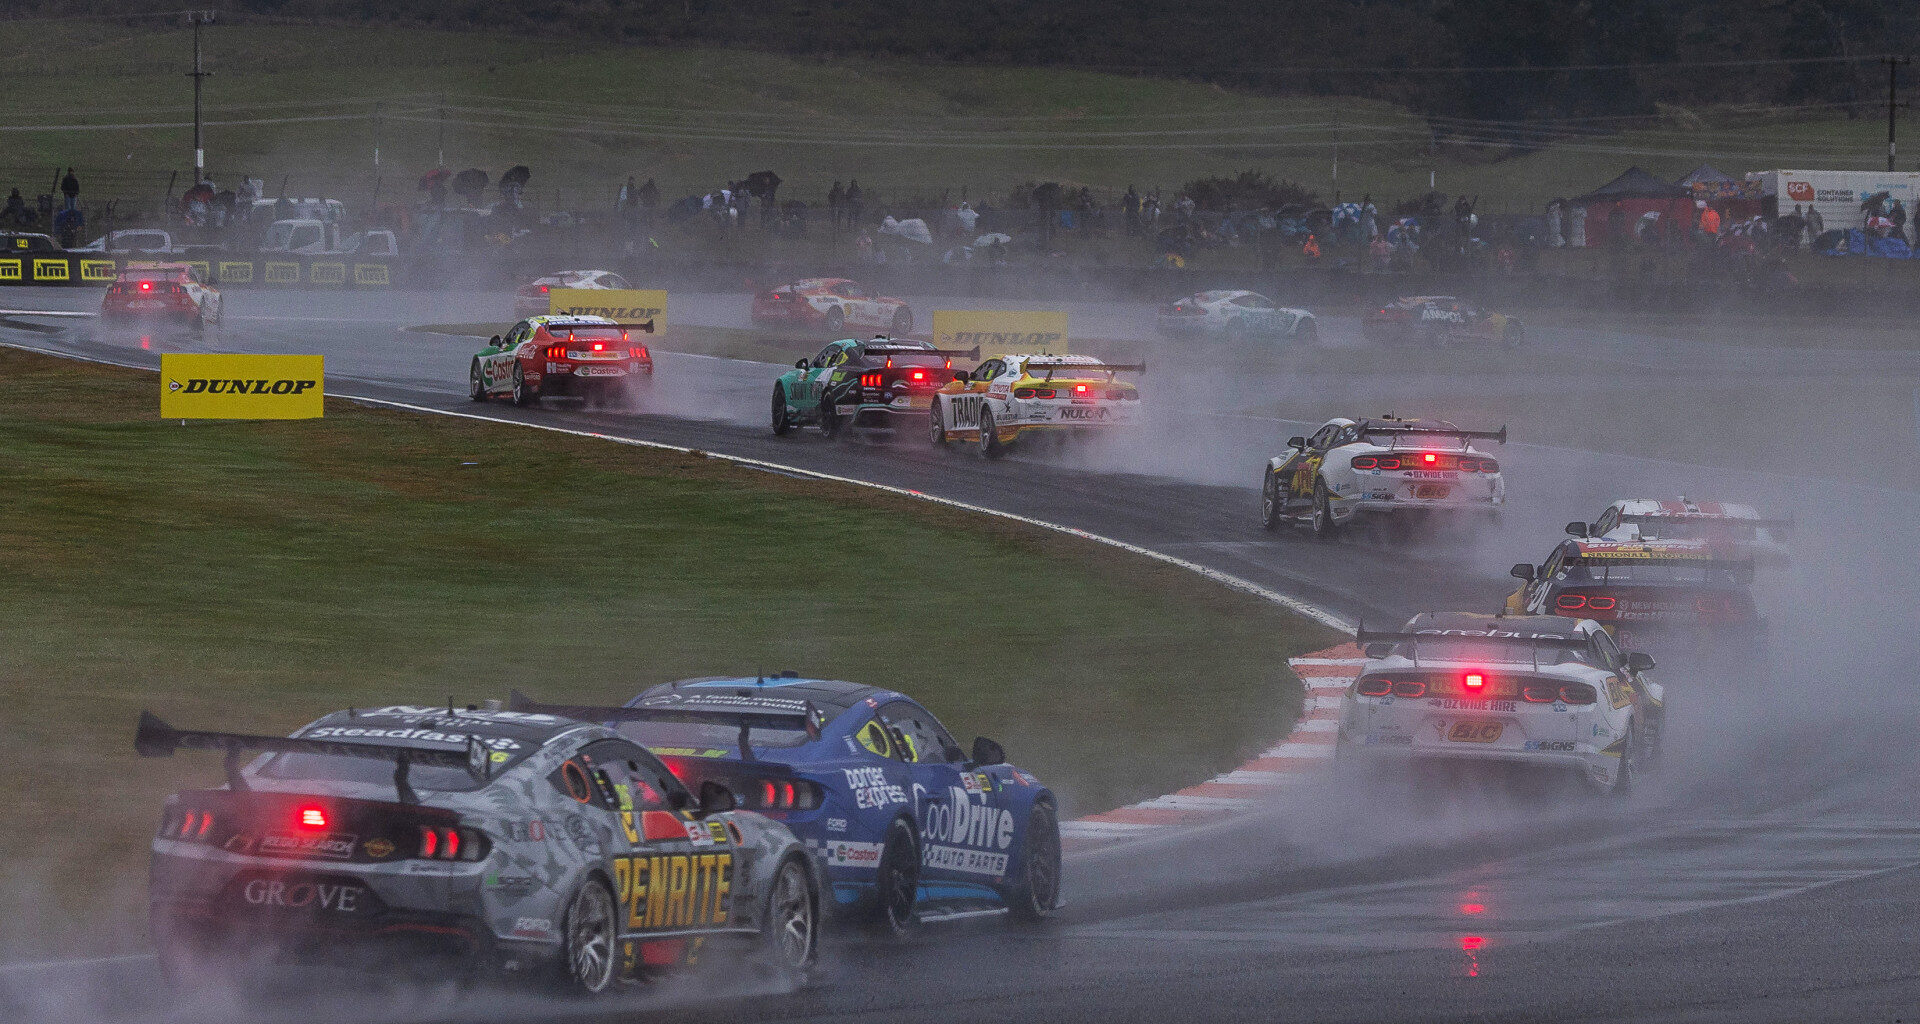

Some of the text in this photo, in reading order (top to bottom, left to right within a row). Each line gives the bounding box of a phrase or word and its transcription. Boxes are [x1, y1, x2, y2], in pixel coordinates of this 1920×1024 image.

[1788, 183, 1809, 193] SCF
[568, 306, 662, 319] DUNLOP
[954, 332, 1061, 346] DUNLOP
[590, 366, 618, 375] Castrol
[182, 379, 316, 395] DUNLOP
[1061, 409, 1105, 419] NULON
[684, 699, 759, 707] Australian
[753, 697, 805, 705] owned
[1453, 725, 1500, 739] BIC
[912, 783, 1015, 849] CoolDrive
[847, 848, 879, 861] Castrol
[935, 849, 1005, 871] AUTO PARTS
[244, 879, 358, 912] GROVE
[613, 853, 732, 929] PENRITE
